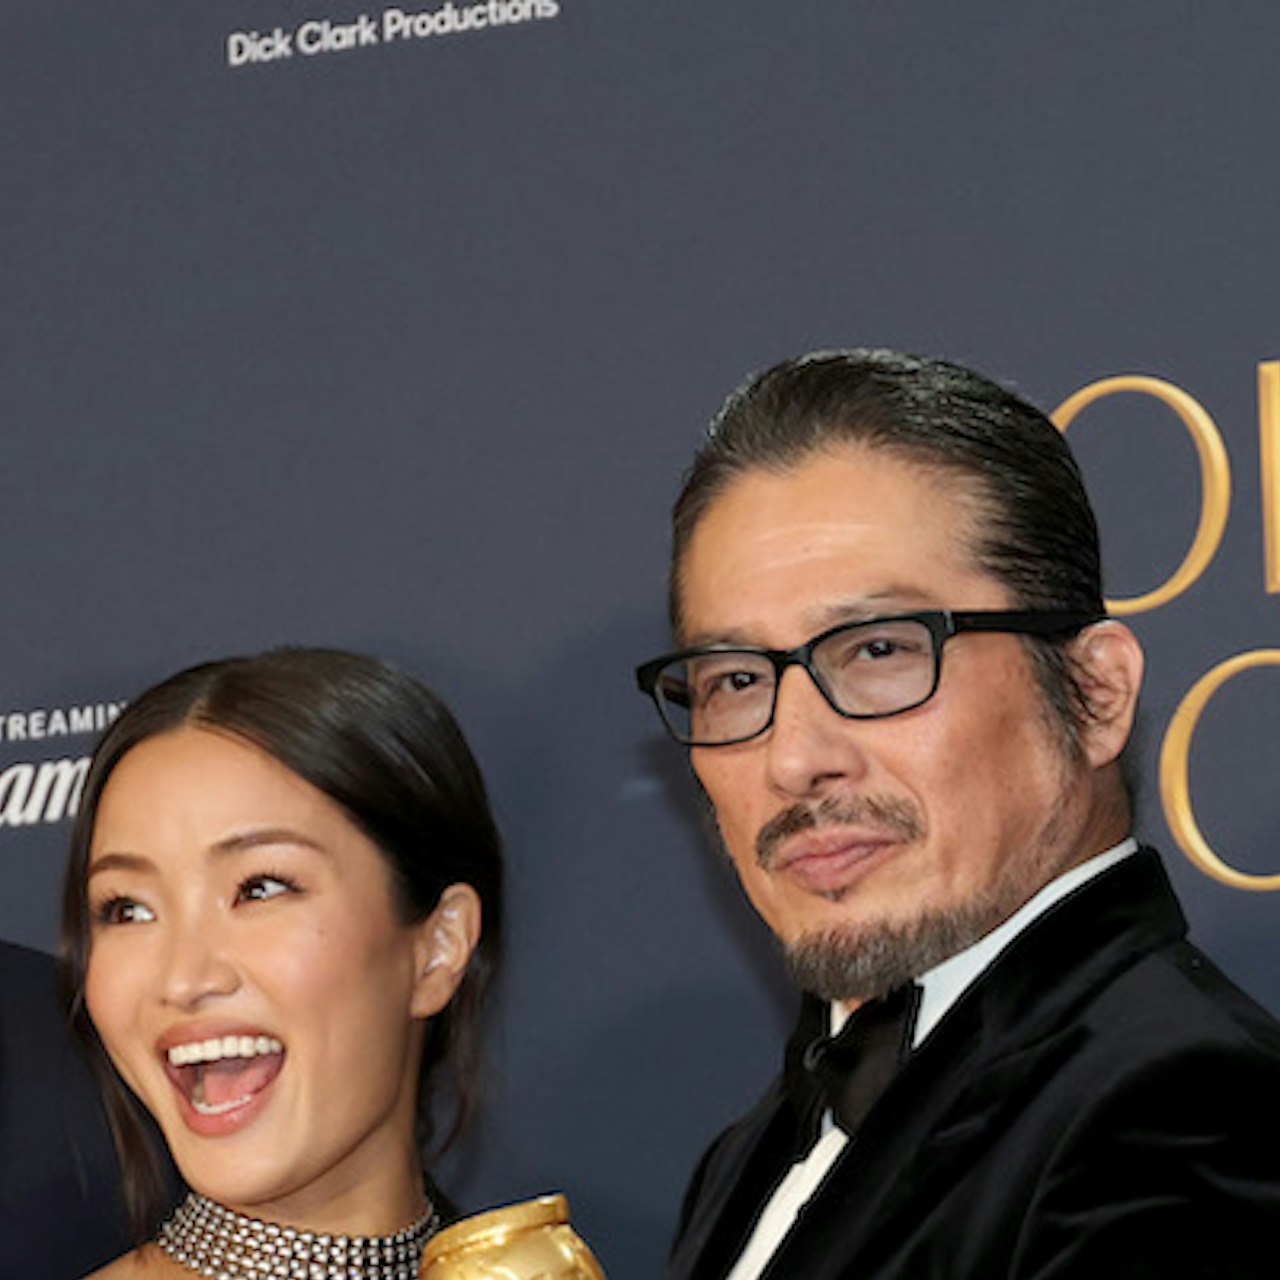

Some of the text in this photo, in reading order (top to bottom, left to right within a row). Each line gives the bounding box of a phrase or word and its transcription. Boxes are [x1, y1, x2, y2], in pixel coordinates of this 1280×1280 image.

[227, 0, 559, 66] Dick Clark Productions
